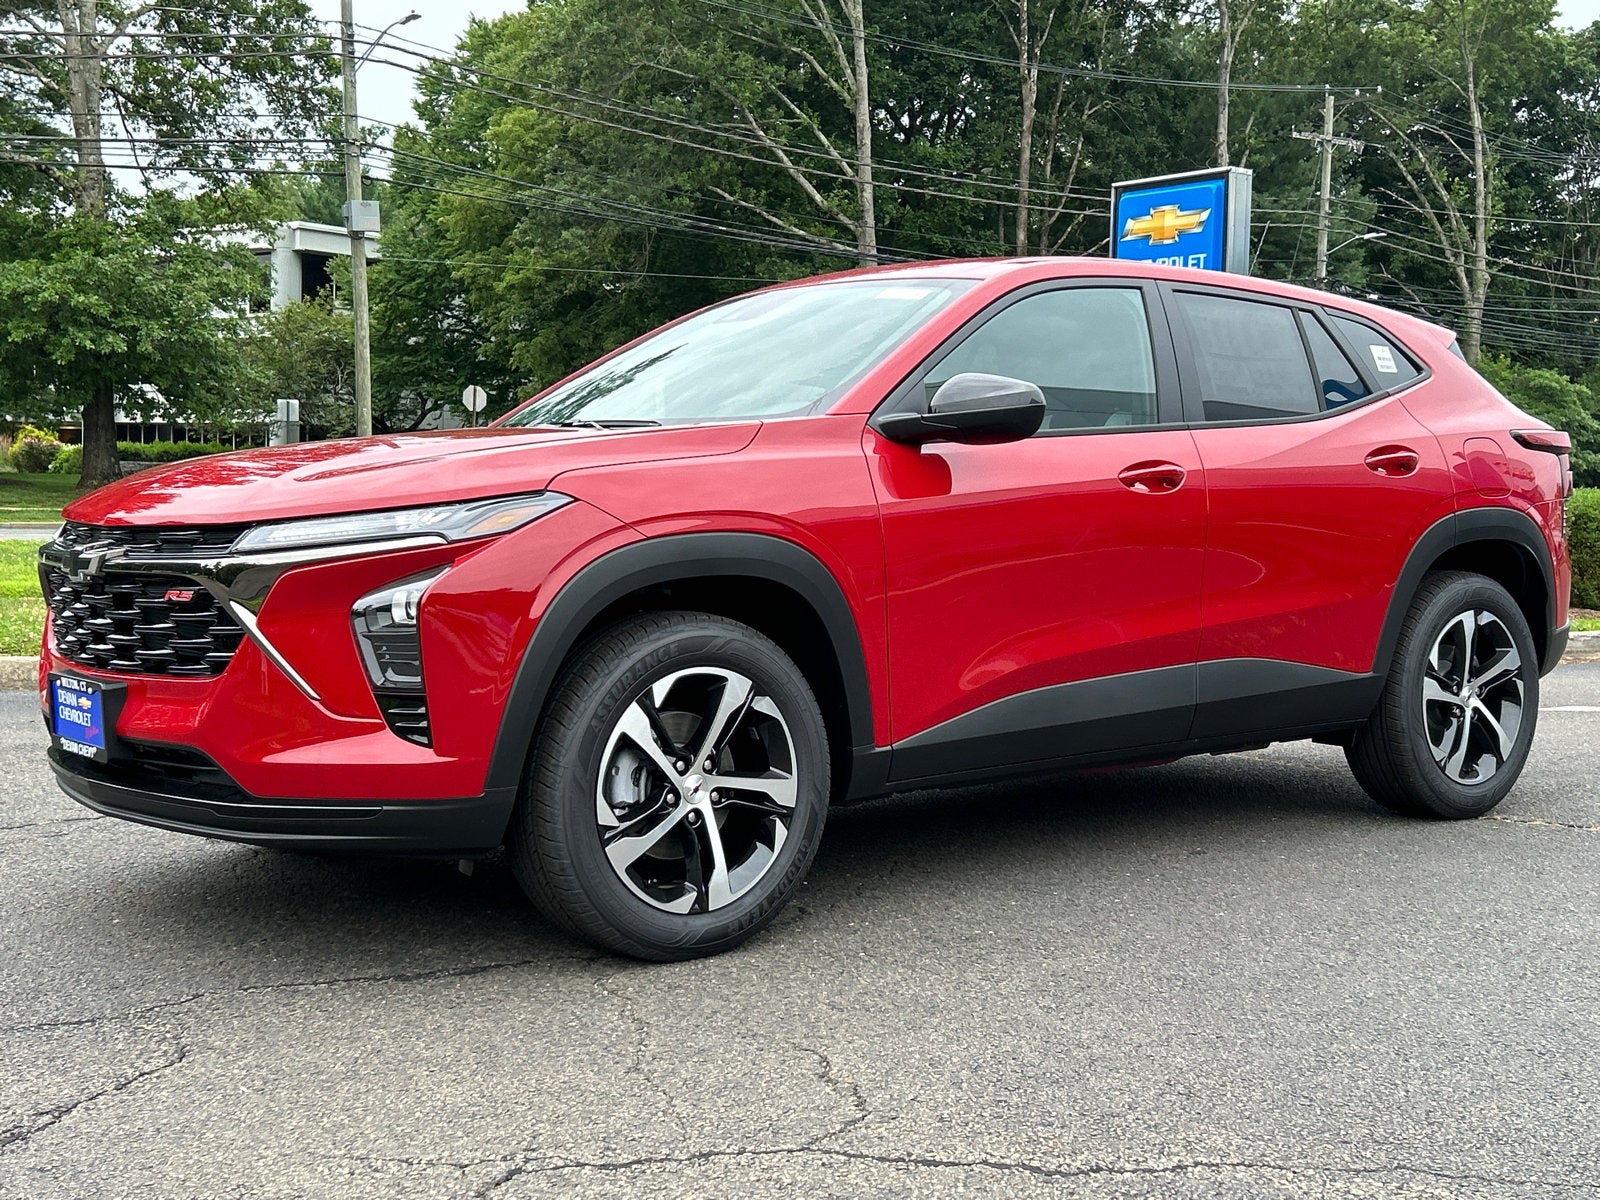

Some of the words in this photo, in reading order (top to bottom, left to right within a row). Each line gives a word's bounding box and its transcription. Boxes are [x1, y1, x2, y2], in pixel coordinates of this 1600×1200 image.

[164, 590, 195, 602] RS
[591, 643, 680, 733] ASSURANCE
[59, 706, 92, 727] CHEVROLET
[727, 839, 810, 932] GOODYEAR
